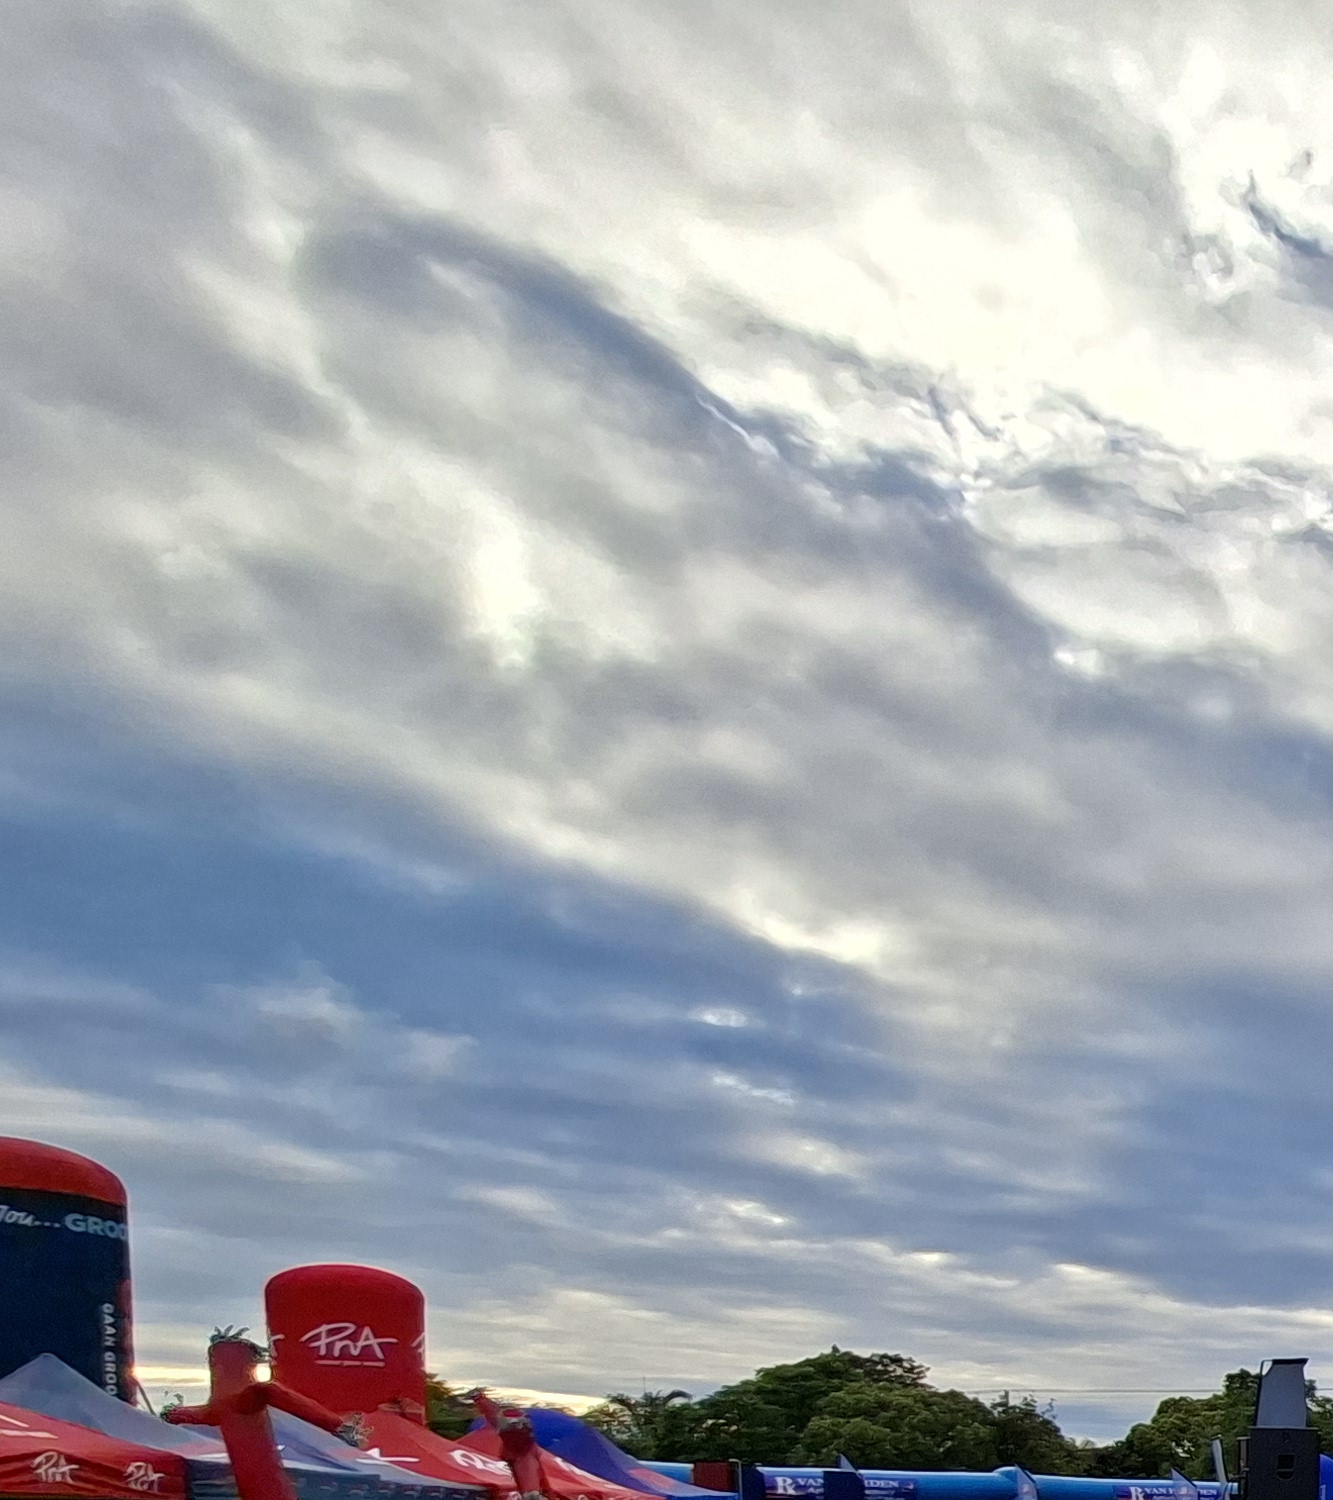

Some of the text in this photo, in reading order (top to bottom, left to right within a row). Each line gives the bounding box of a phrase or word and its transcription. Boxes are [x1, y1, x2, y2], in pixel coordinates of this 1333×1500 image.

[64, 1212, 128, 1241] GROO
[102, 1303, 118, 1396] GAAN GROO
